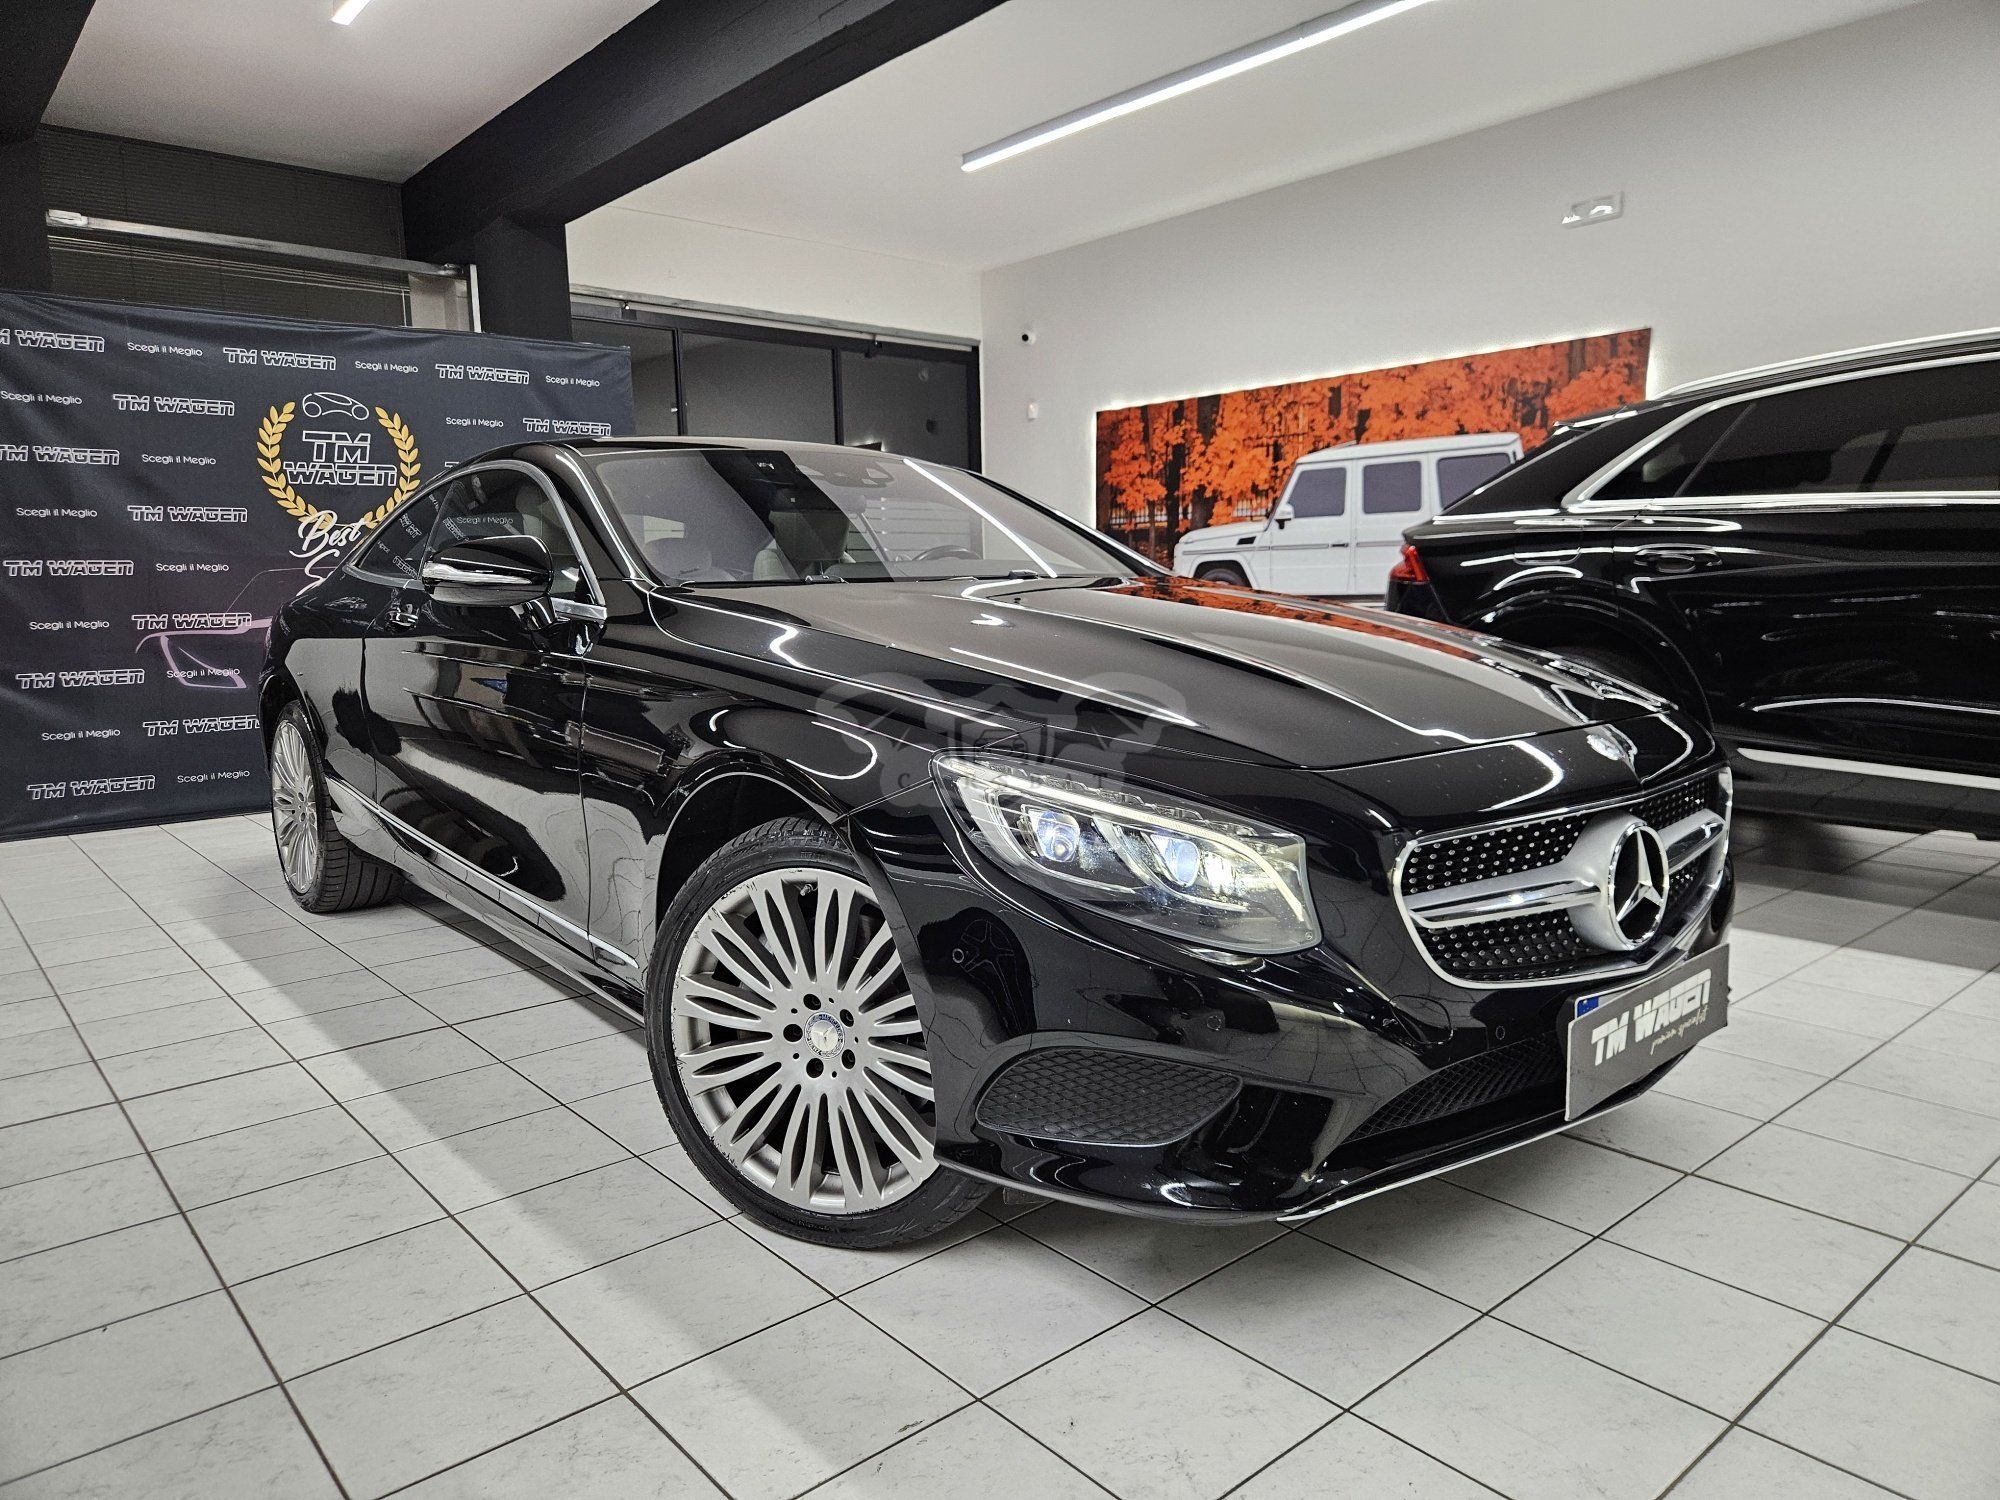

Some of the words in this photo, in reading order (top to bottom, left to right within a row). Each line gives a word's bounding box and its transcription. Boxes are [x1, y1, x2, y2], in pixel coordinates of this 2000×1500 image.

[14, 329, 105, 353] WAGEN
[127, 341, 160, 354] Scegli
[161, 345, 168, 354] il
[169, 346, 203, 357] Meglio
[223, 347, 258, 365] TM
[261, 350, 337, 371] WAGEN
[354, 360, 382, 372] Scegli
[383, 363, 388, 371] il
[389, 363, 419, 374] Meglio
[435, 363, 464, 380] TM
[466, 365, 530, 385] WAGEN
[545, 375, 569, 386] Scegli
[569, 377, 574, 385] il
[575, 378, 600, 388] Meglio
[0, 390, 36, 403] Scegli
[37, 393, 43, 402] il
[45, 394, 82, 405] Meglio
[112, 393, 150, 412] TM
[154, 396, 235, 417] WAGEN
[445, 417, 471, 427] Scegli
[472, 419, 477, 427] il
[478, 418, 504, 429] Meglio
[522, 417, 550, 433] TM
[552, 419, 612, 437] WAGEN
[32, 445, 120, 466] WAGEN
[302, 430, 371, 463] TM
[141, 454, 175, 465] Scegli
[176, 455, 181, 463] il
[182, 455, 217, 466] Meglio
[283, 461, 398, 487] WAGEN
[16, 507, 51, 518] Scegli
[53, 508, 60, 517] il
[61, 508, 98, 519] Meglio
[127, 505, 164, 522] TM
[167, 505, 248, 523] WAGEN
[289, 509, 367, 558] Best
[3, 560, 43, 577] TM
[47, 559, 135, 576] WAGEN
[155, 563, 187, 573] Scegli
[189, 563, 195, 572] il
[196, 562, 229, 573] Meglio
[29, 621, 64, 631] Scegli
[66, 620, 72, 629] il
[74, 619, 110, 630] Meglio
[131, 614, 168, 630] TM
[172, 612, 252, 629] WAGEN
[15, 672, 55, 689] TM
[59, 668, 145, 688] WAGEN
[166, 668, 199, 679] Scegli
[200, 668, 206, 677] il
[207, 667, 241, 677] Meglio
[41, 731, 76, 742] Scegli
[77, 730, 84, 739] il
[85, 728, 121, 739] Meglio
[143, 720, 179, 737] TM
[177, 773, 209, 784] Scegli
[210, 772, 216, 781] il
[217, 769, 251, 781] Meglio
[27, 783, 65, 800] TM
[70, 775, 156, 798] WAGEN
[1591, 1011, 1630, 1066] TM
